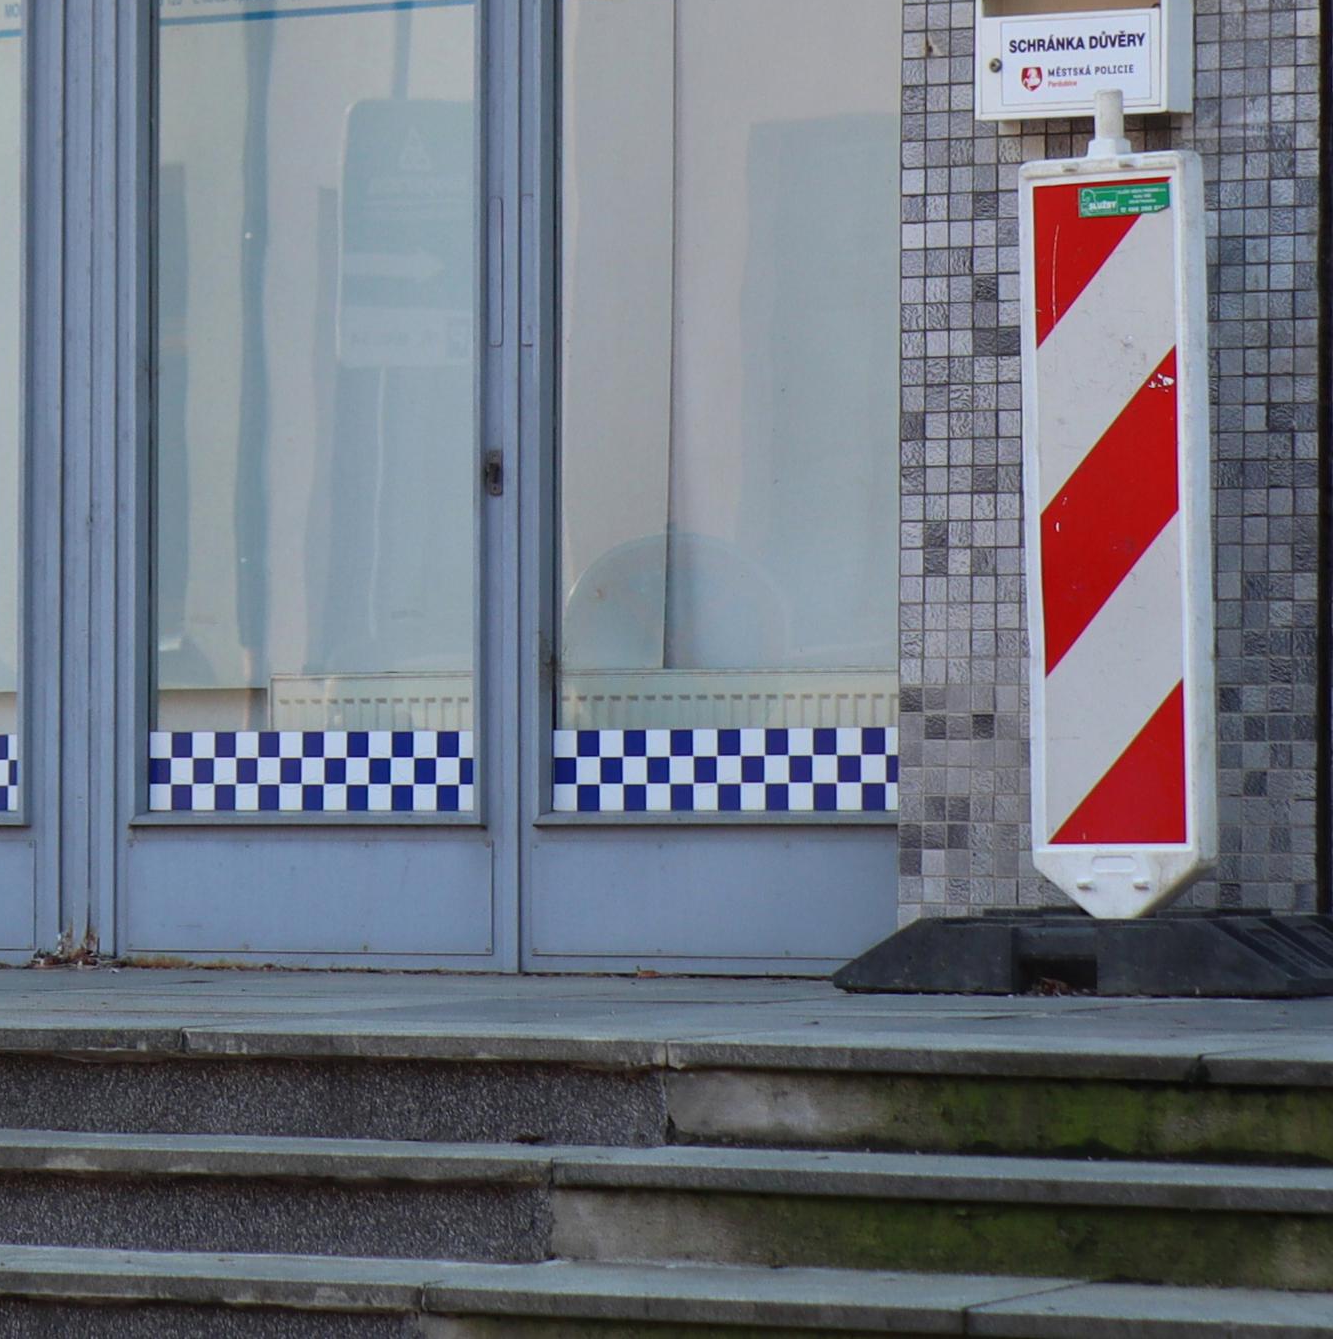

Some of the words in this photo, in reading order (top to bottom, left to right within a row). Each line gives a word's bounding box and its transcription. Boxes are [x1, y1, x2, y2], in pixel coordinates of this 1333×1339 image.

[1009, 34, 1085, 53] SCHRÁNKA
[1089, 31, 1146, 49] DŮVĚRY
[1047, 65, 1092, 77] MĚSTSKÁ
[1094, 64, 1135, 75] POLICIE
